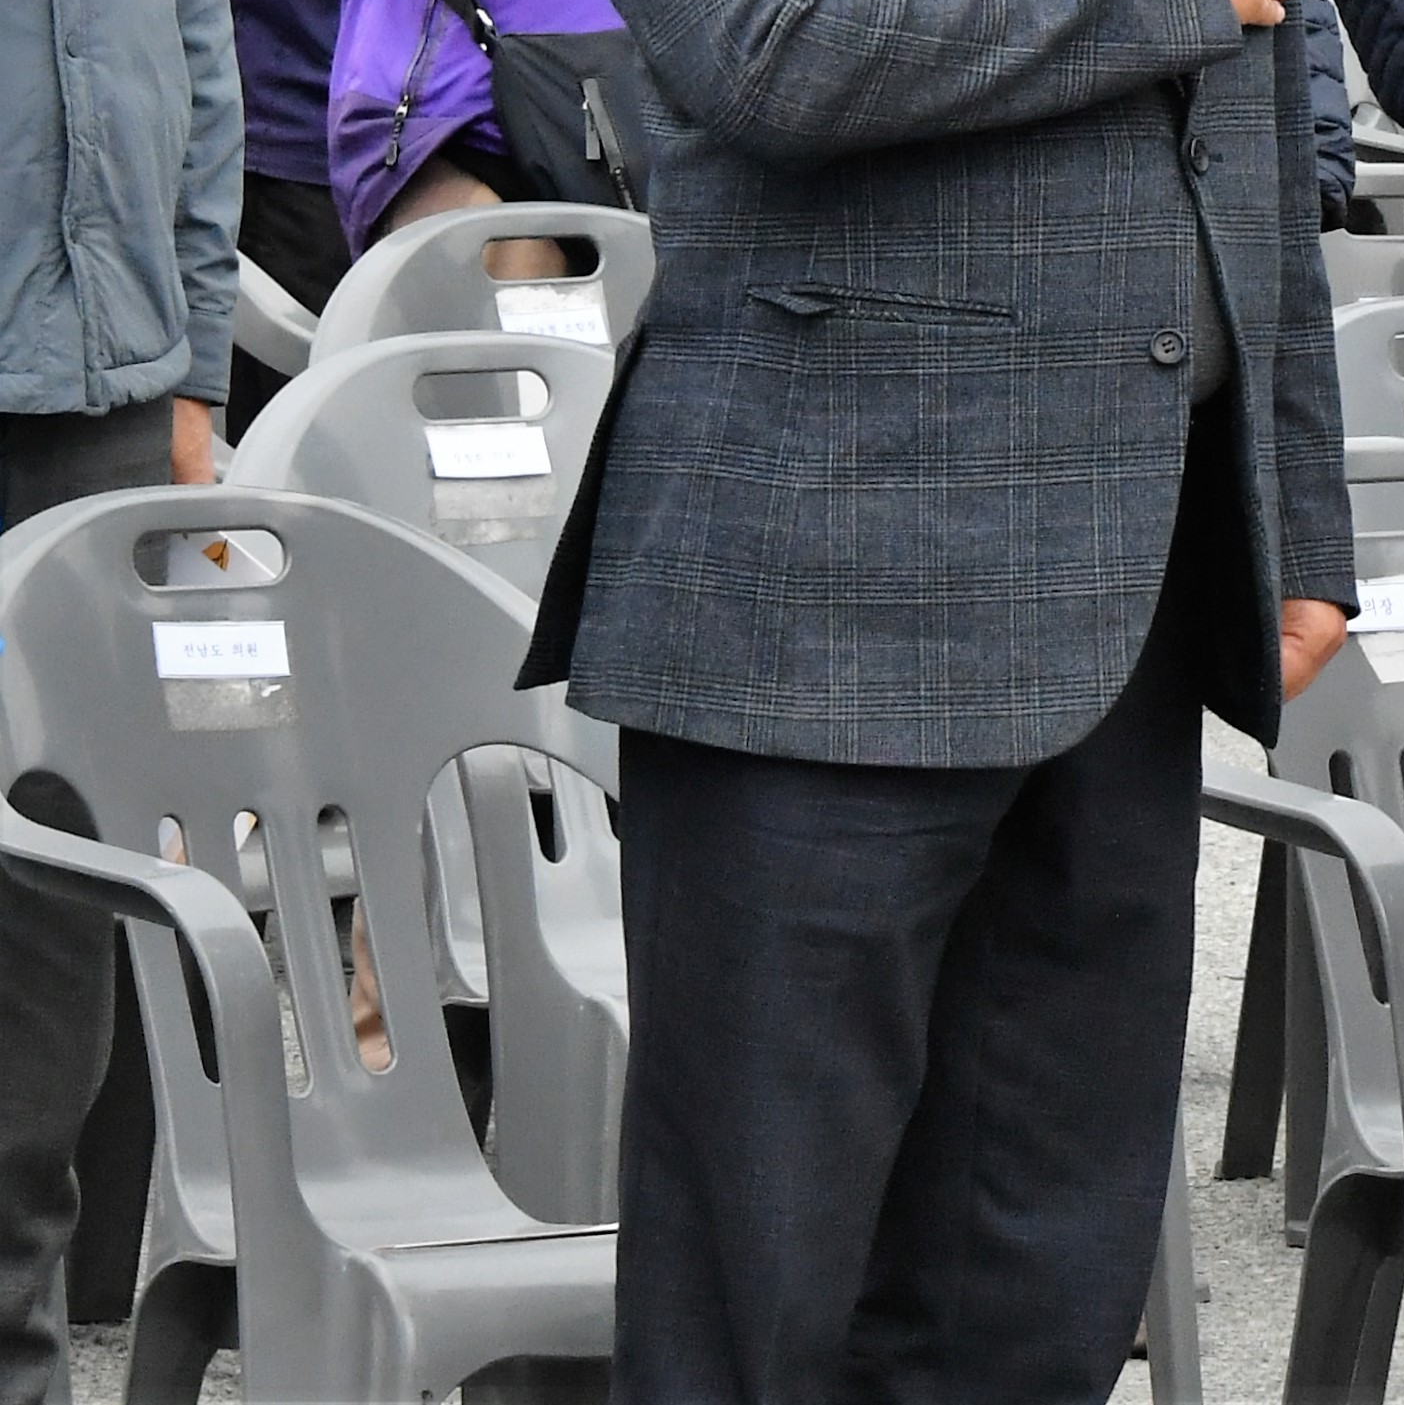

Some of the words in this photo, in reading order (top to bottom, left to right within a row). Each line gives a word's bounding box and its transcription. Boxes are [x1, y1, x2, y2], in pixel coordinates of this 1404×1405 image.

[1364, 598, 1392, 616] 의장
[183, 642, 224, 658] 전남도
[231, 642, 258, 658] 의원
